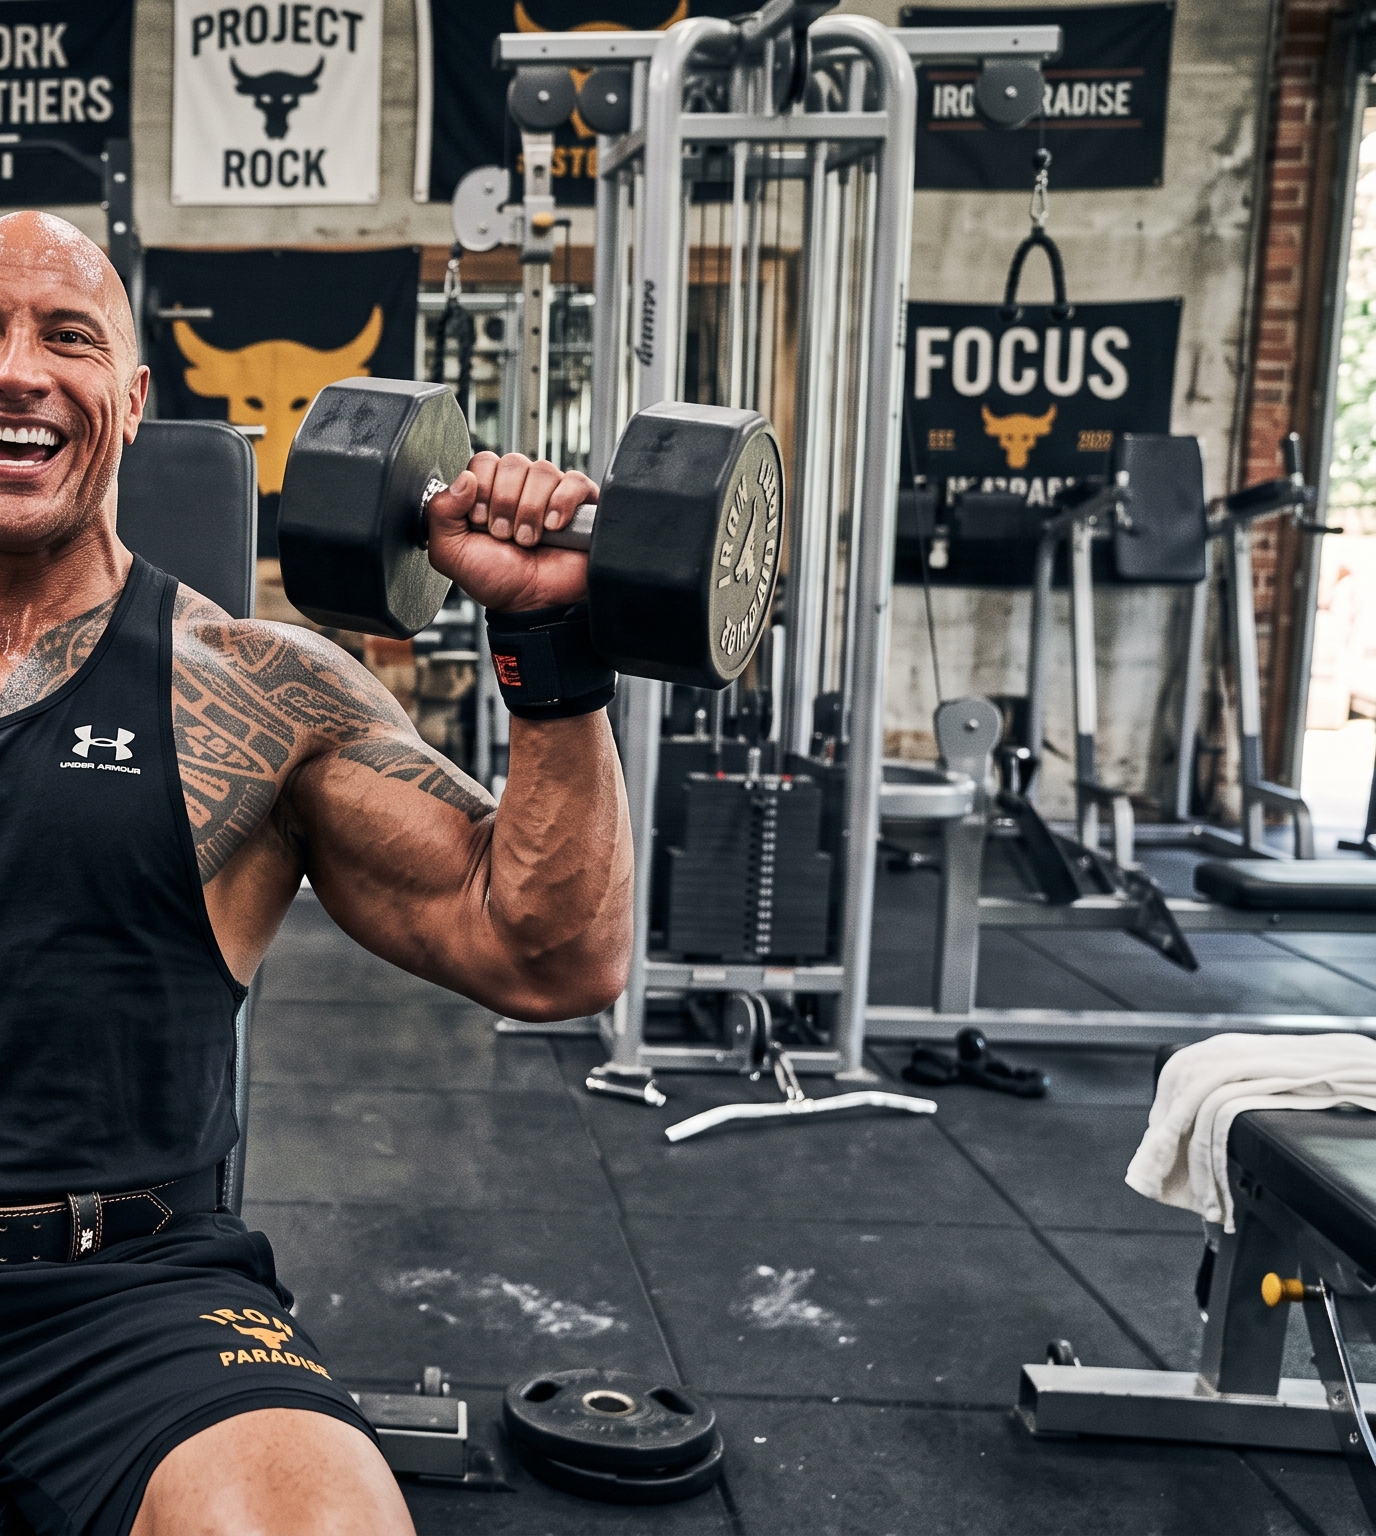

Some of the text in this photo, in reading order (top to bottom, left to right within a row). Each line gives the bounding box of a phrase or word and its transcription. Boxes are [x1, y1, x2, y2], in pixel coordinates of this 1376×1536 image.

[191, 4, 364, 56] PROJECT
[933, 84, 975, 117] IRO
[223, 149, 326, 188] ROCK
[914, 326, 1131, 400] FOCUS
[96, 763, 141, 775] ARMOUR
[199, 1308, 294, 1338] IRON
